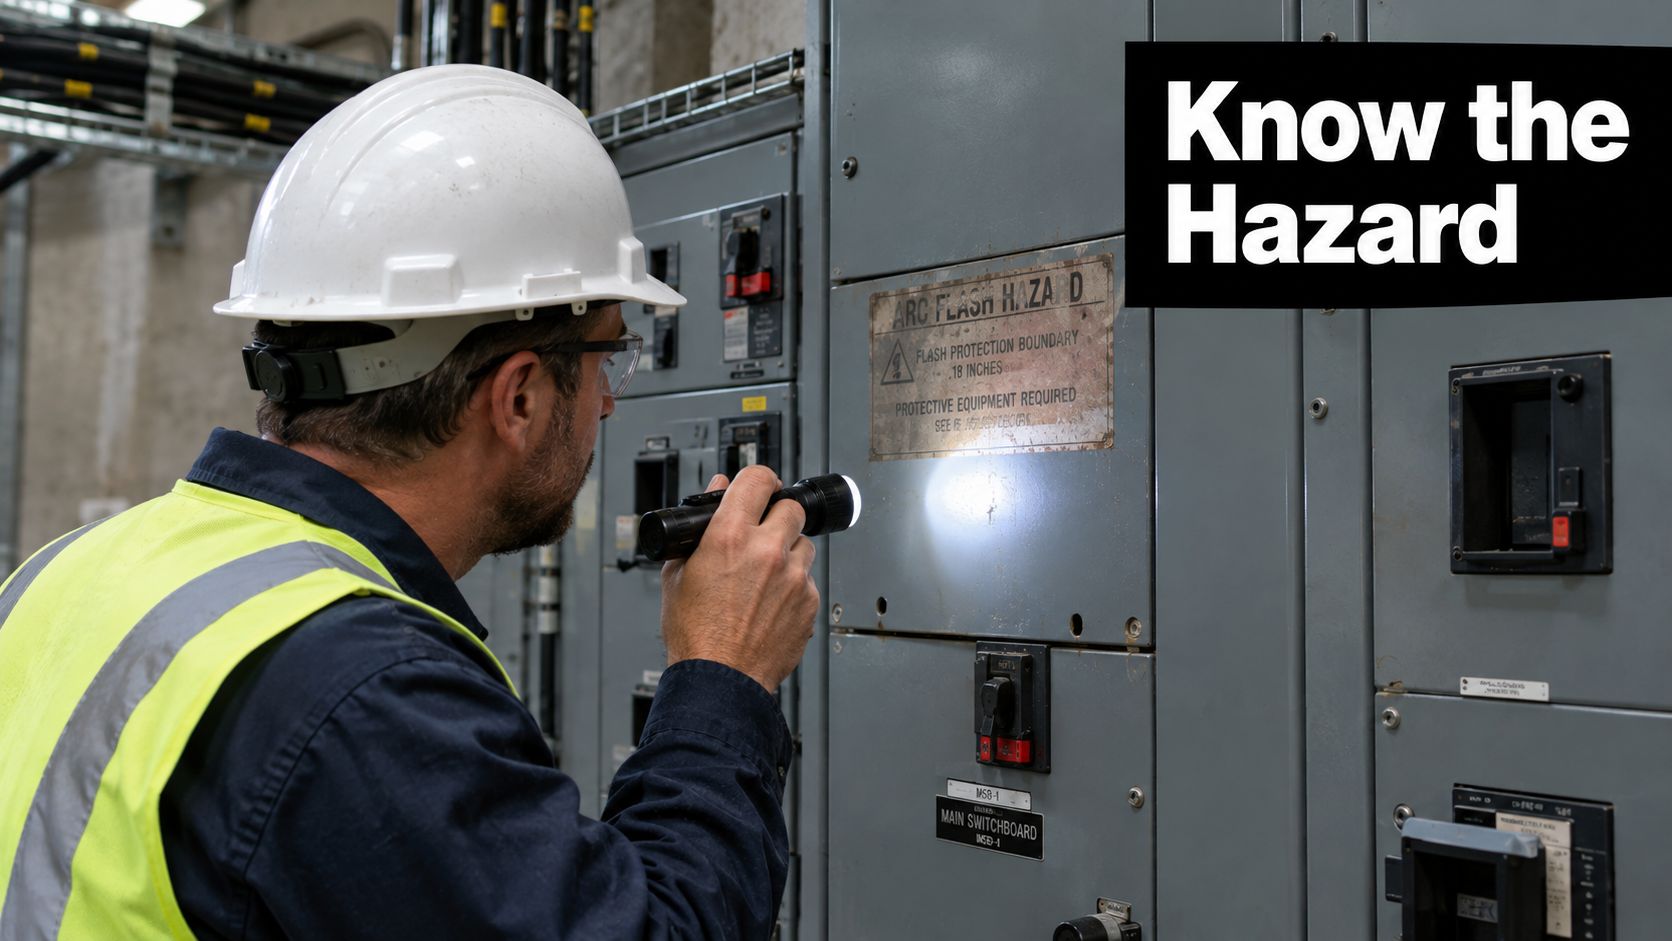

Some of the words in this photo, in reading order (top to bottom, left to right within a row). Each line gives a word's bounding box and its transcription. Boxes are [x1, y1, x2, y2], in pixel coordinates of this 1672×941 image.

[892, 297, 929, 330] ARC
[936, 287, 994, 322] FLASH
[916, 349, 947, 364] FLASH
[950, 337, 1014, 360] PROTECTION
[1019, 329, 1079, 350] BOUNDARY
[966, 360, 1003, 378] INCHES
[895, 398, 953, 417] PROTECTIVE
[957, 392, 1017, 413] EQUIPMENT
[1021, 386, 1077, 407] REQUIRED
[941, 808, 965, 827] MAIN
[967, 813, 1037, 841] SWITCHBOARD
